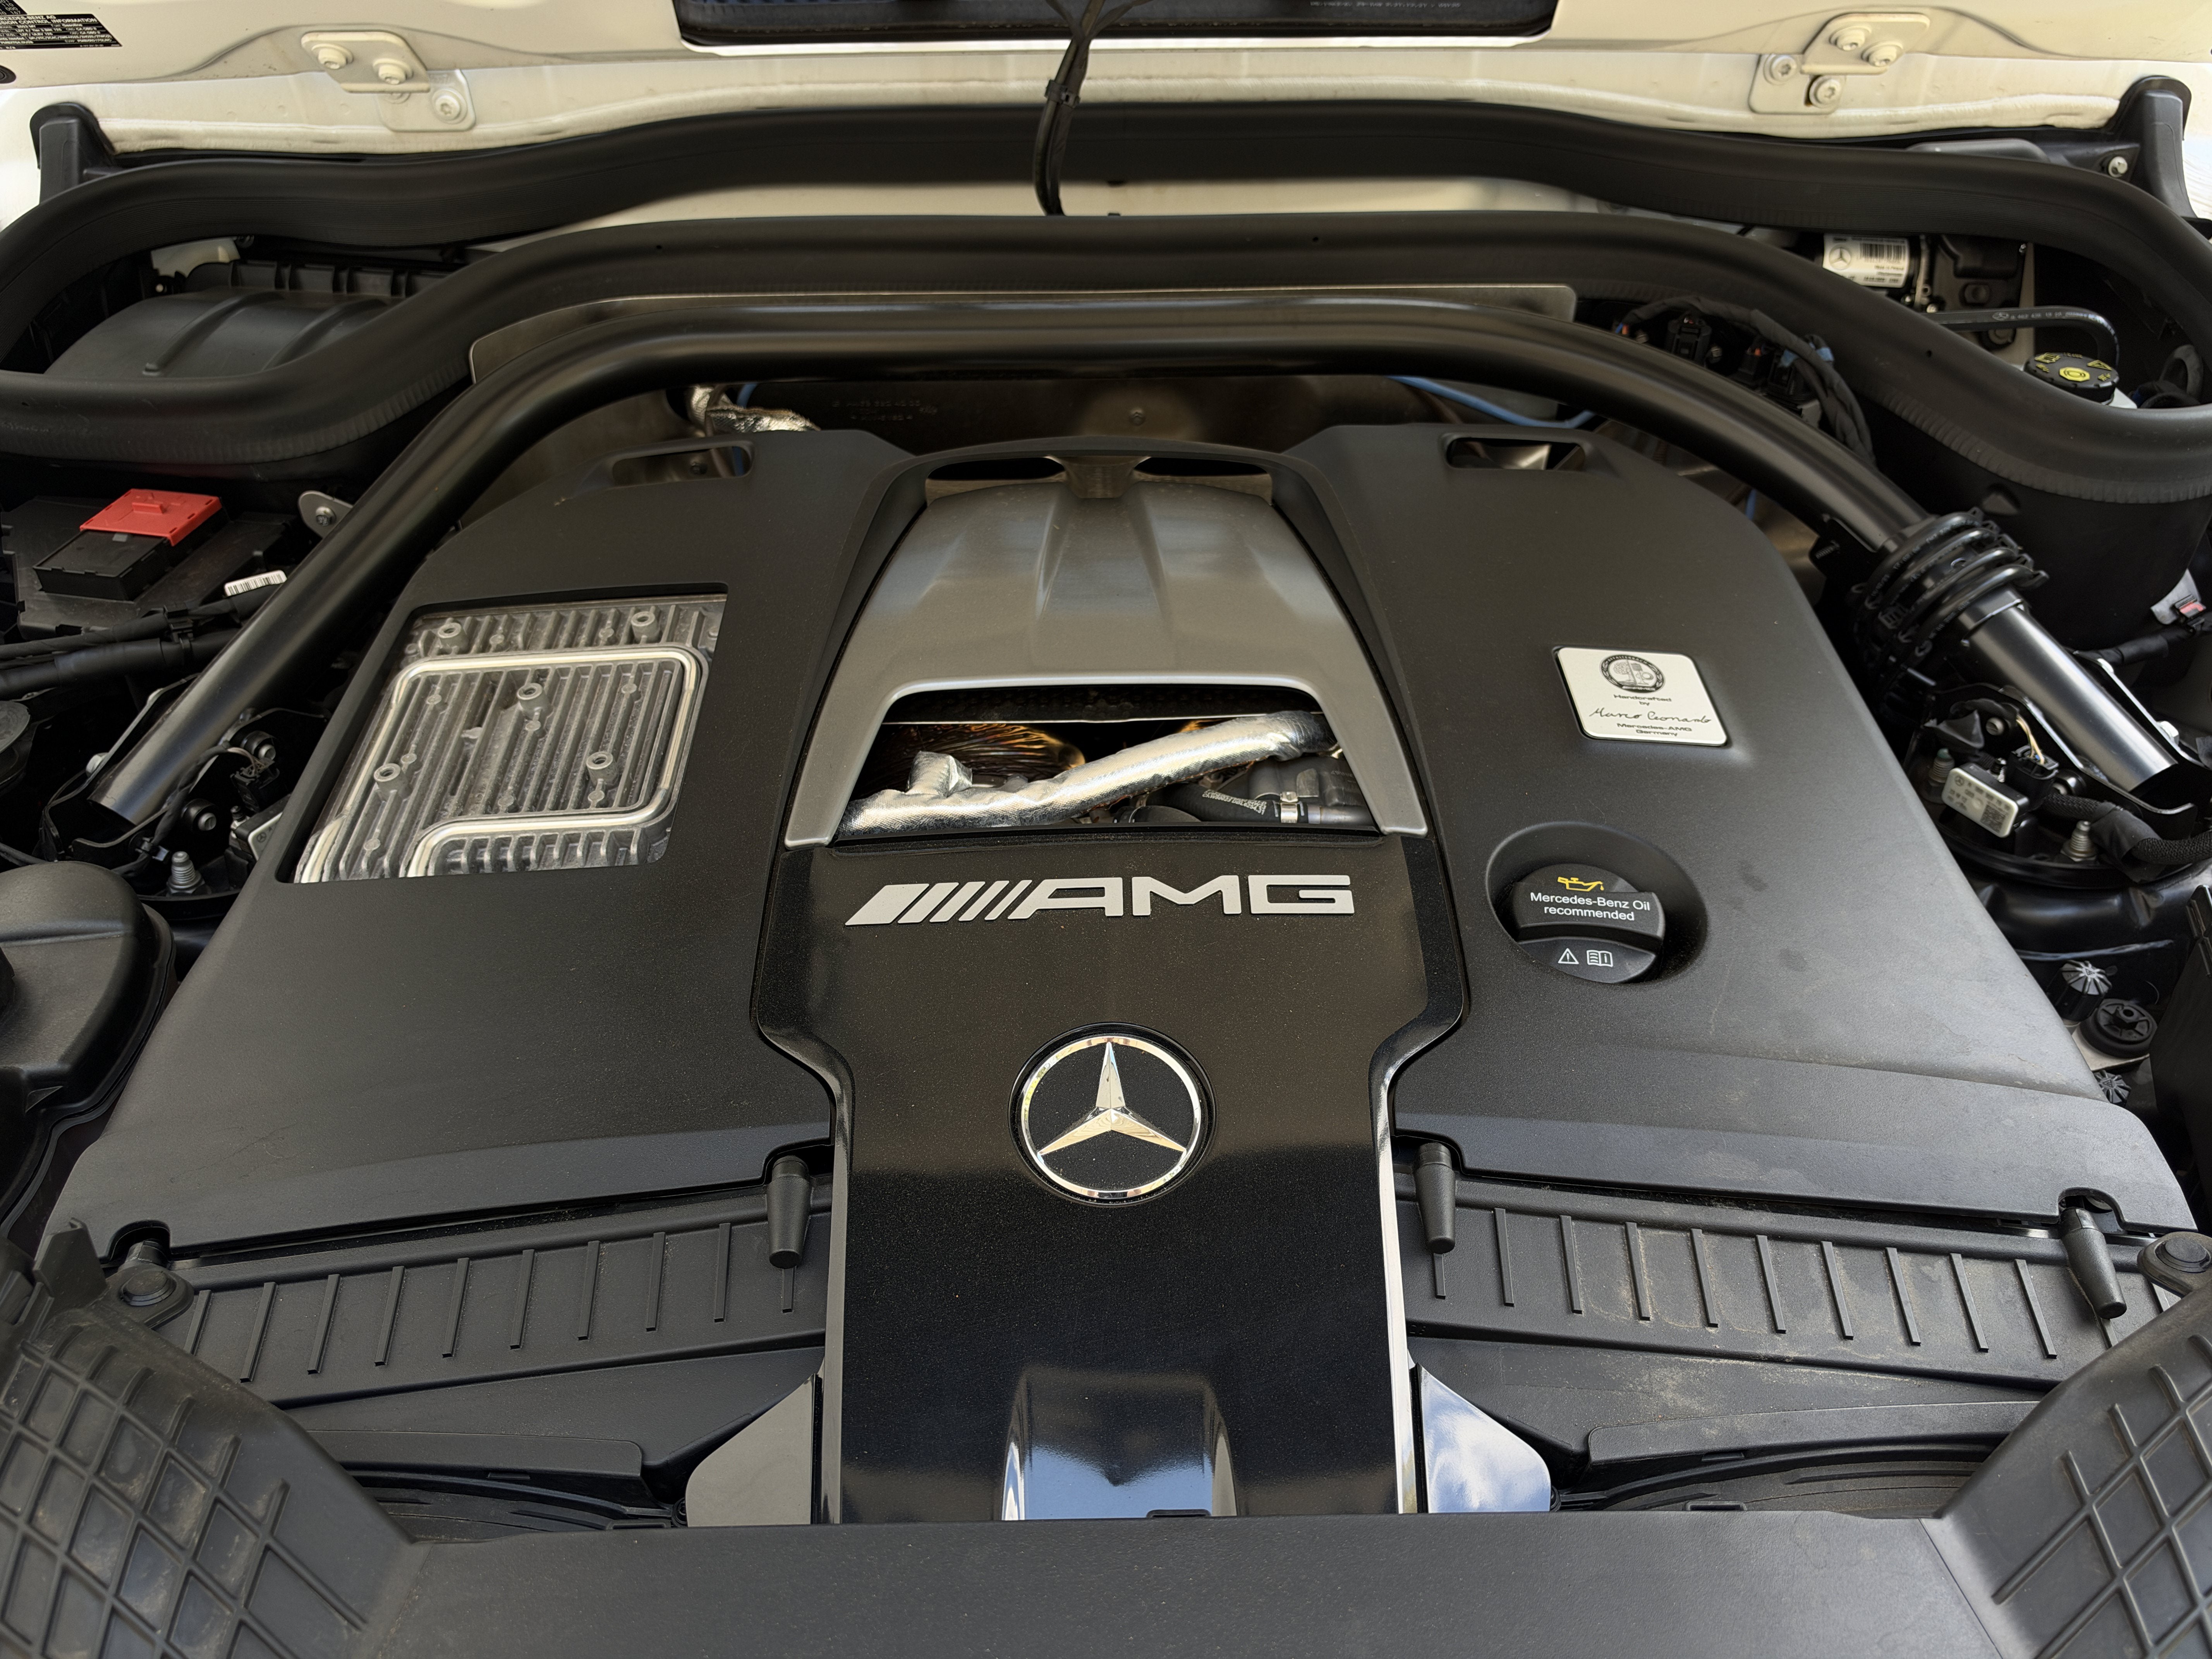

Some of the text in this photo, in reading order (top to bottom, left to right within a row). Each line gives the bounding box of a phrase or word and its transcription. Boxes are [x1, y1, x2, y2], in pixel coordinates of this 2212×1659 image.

[1589, 708, 1642, 719] Marco
[1617, 723, 1692, 732] Mercedes-AMG
[1008, 874, 1355, 921] AMG
[1530, 892, 1650, 911] Mercedes-Benz Oil
[1544, 907, 1635, 921] recommended
